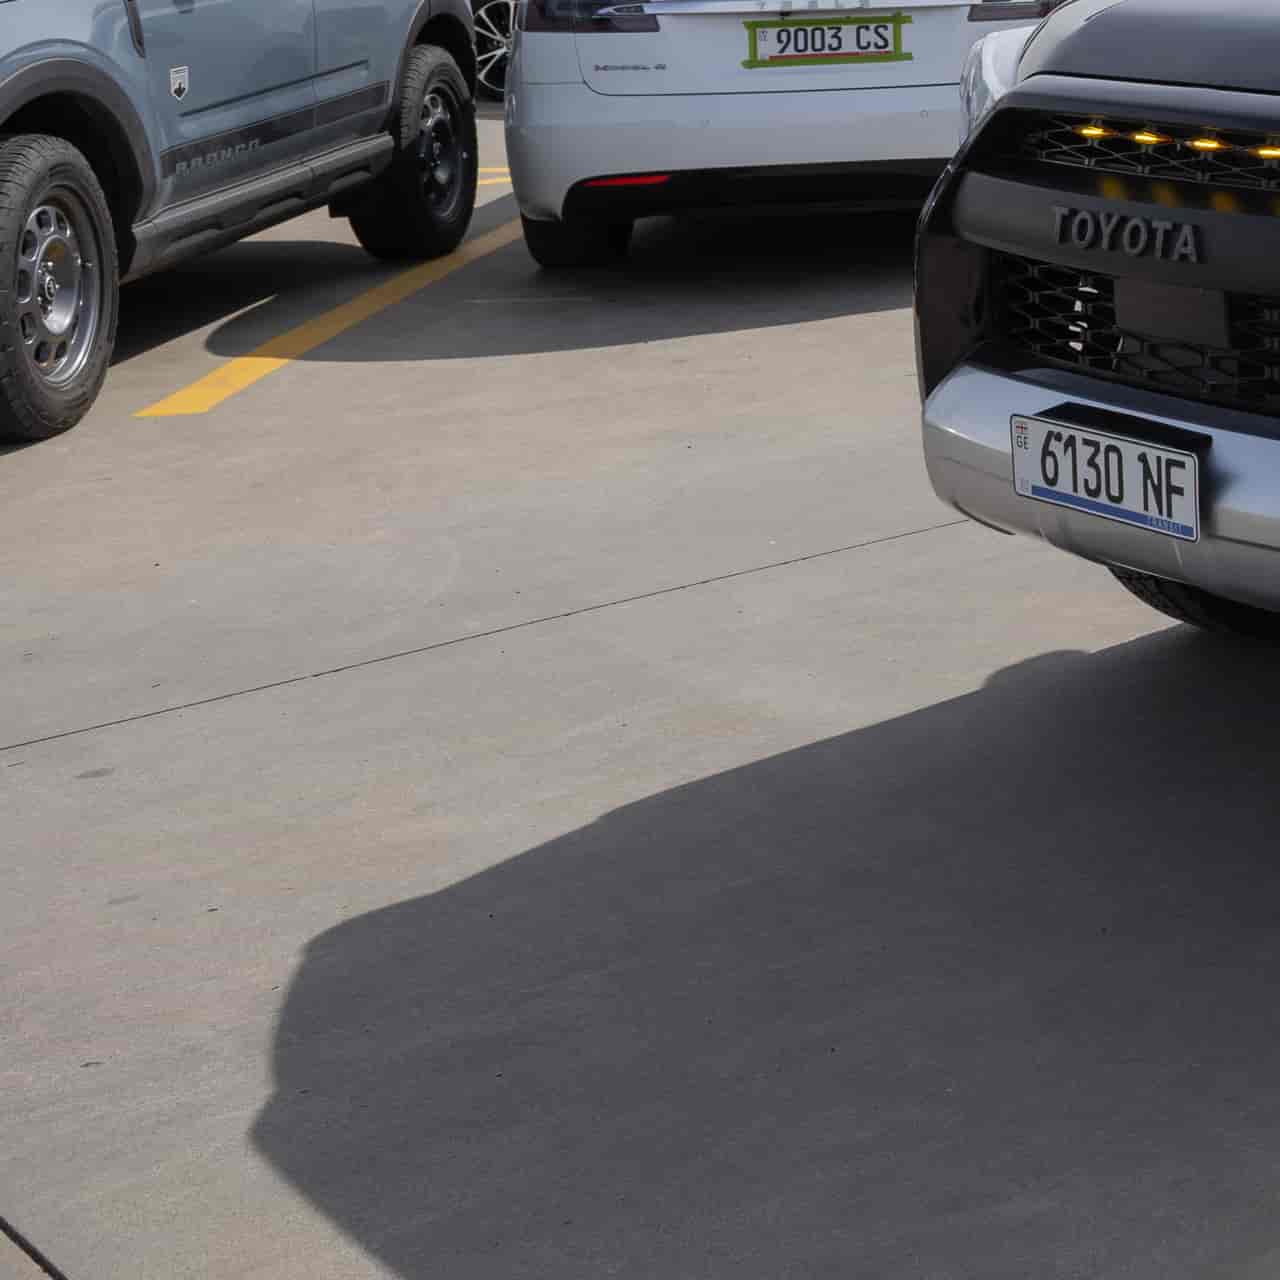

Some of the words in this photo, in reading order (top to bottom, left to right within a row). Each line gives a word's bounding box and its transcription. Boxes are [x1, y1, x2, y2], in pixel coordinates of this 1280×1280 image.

[776, 26, 843, 54] 9003
[855, 24, 889, 50] CS
[1053, 206, 1199, 264] TOYOTA
[1040, 430, 1124, 505] 6130
[1137, 451, 1187, 519] NF
